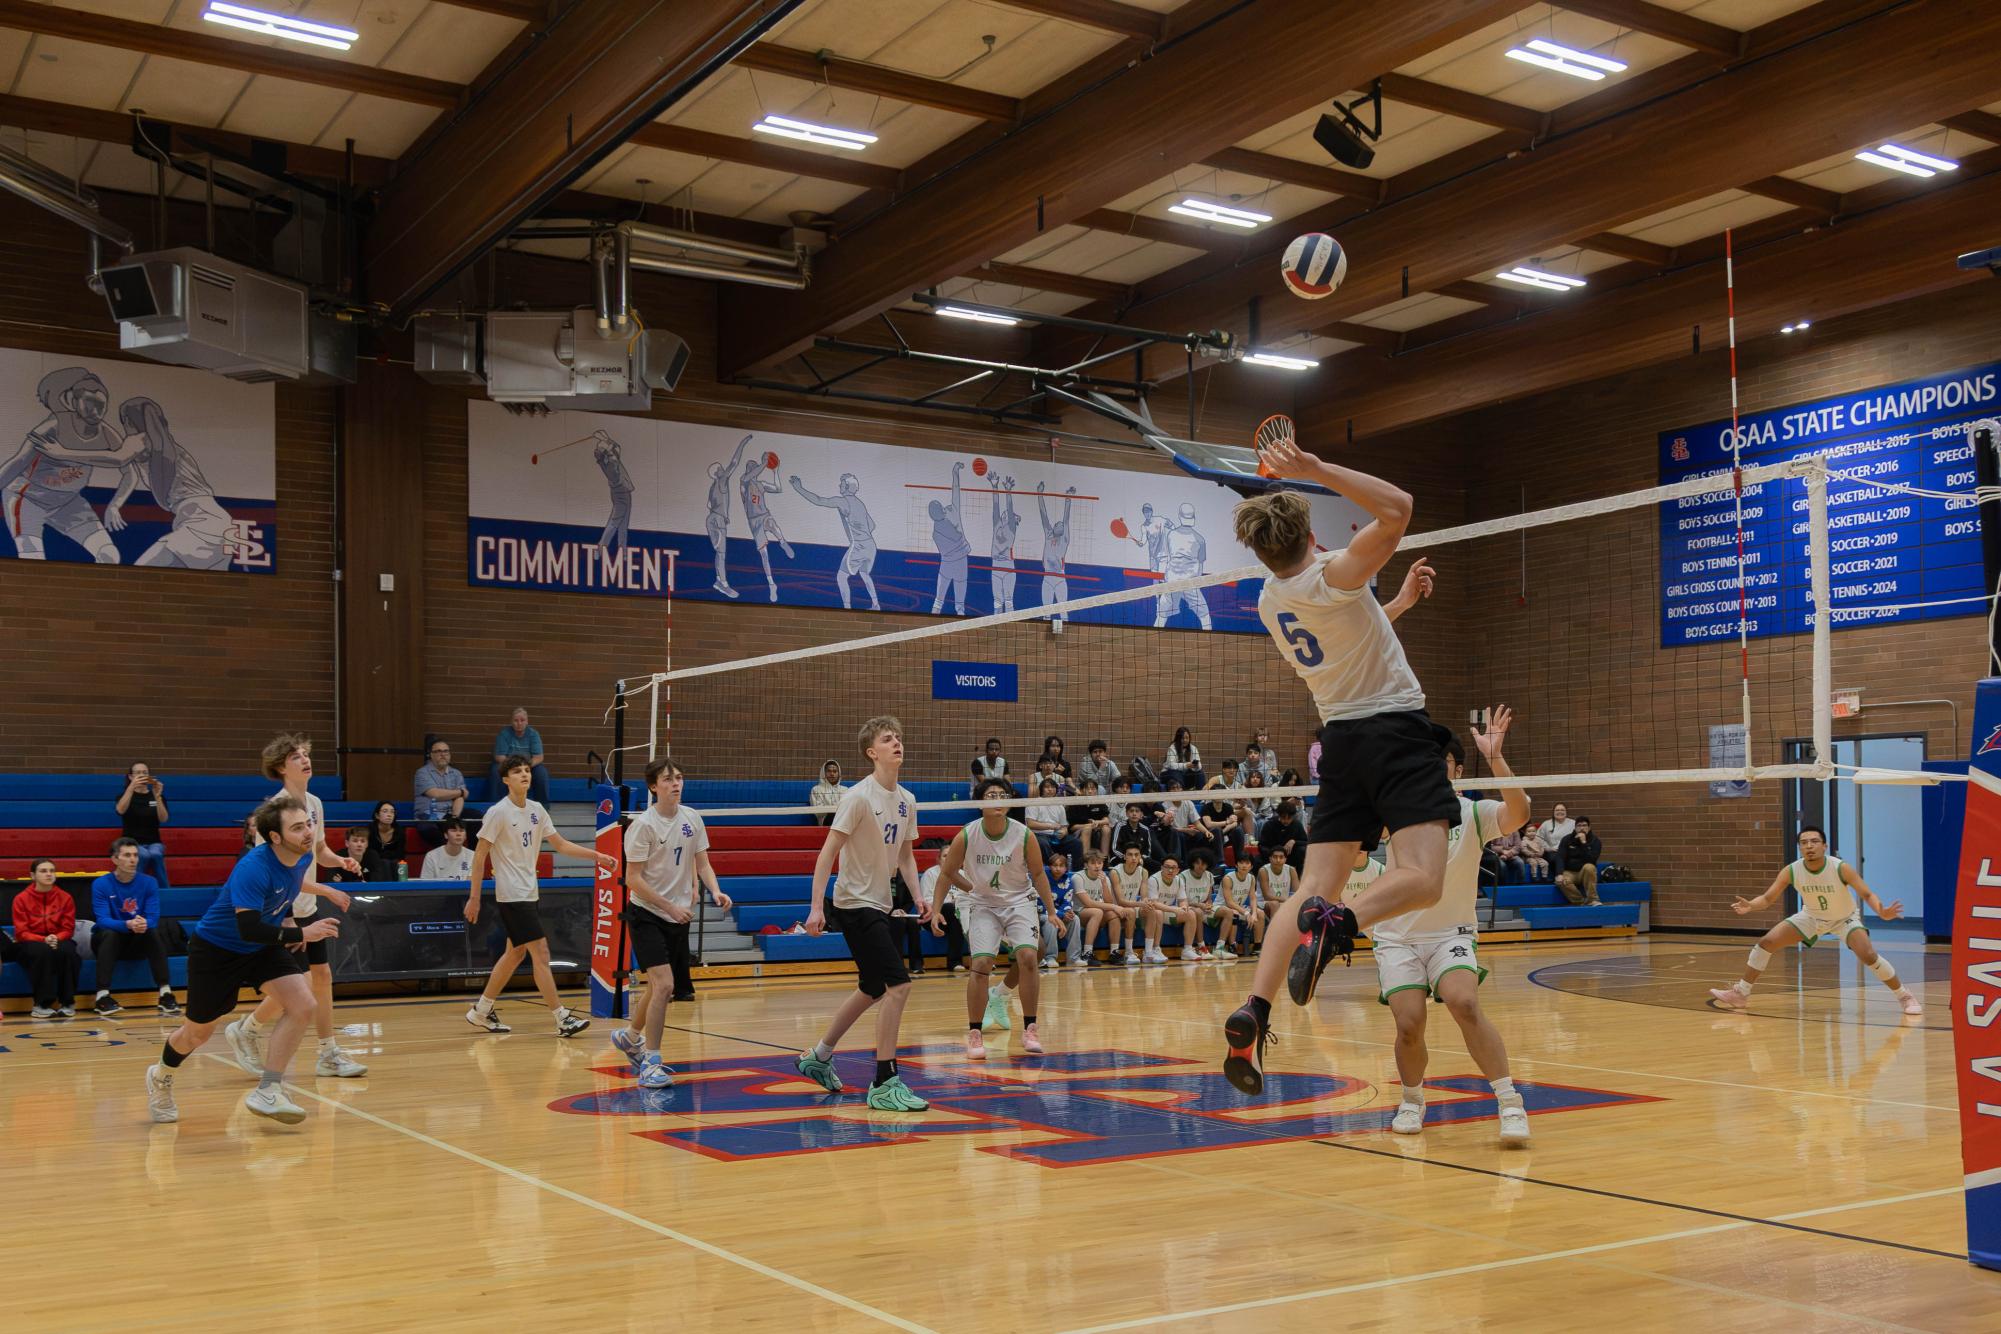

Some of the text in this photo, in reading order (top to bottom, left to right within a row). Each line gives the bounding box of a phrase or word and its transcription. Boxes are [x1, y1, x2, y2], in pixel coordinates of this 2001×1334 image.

[1720, 420, 1777, 451] OSAA
[1782, 405, 1844, 441] STATE
[1850, 374, 1996, 425] CHAMPIONS
[1932, 423, 1960, 440] BOYS
[1933, 447, 1974, 464] SPEECH
[1947, 471, 1975, 487] BOYS
[1679, 494, 1701, 508] BOYS
[1679, 516, 1701, 530] BOYS
[1945, 521, 1974, 536] BOYS
[477, 536, 680, 592] COMMITMENT
[1682, 560, 1704, 573] BOYS
[1706, 555, 1738, 569] TENNIS
[1667, 584, 1688, 597] GIRLS
[1690, 581, 1715, 594] CROSS
[1668, 607, 1688, 618] BOYS
[1689, 603, 1714, 616] CROSS
[1277, 612, 1324, 667] 5
[1685, 626, 1708, 639] BOYS
[955, 674, 997, 687] VISITORS
[522, 831, 533, 848] 31
[884, 823, 898, 845] 21
[673, 846, 683, 866] 7
[990, 870, 1000, 890] 4
[593, 865, 614, 959] A SALLE
